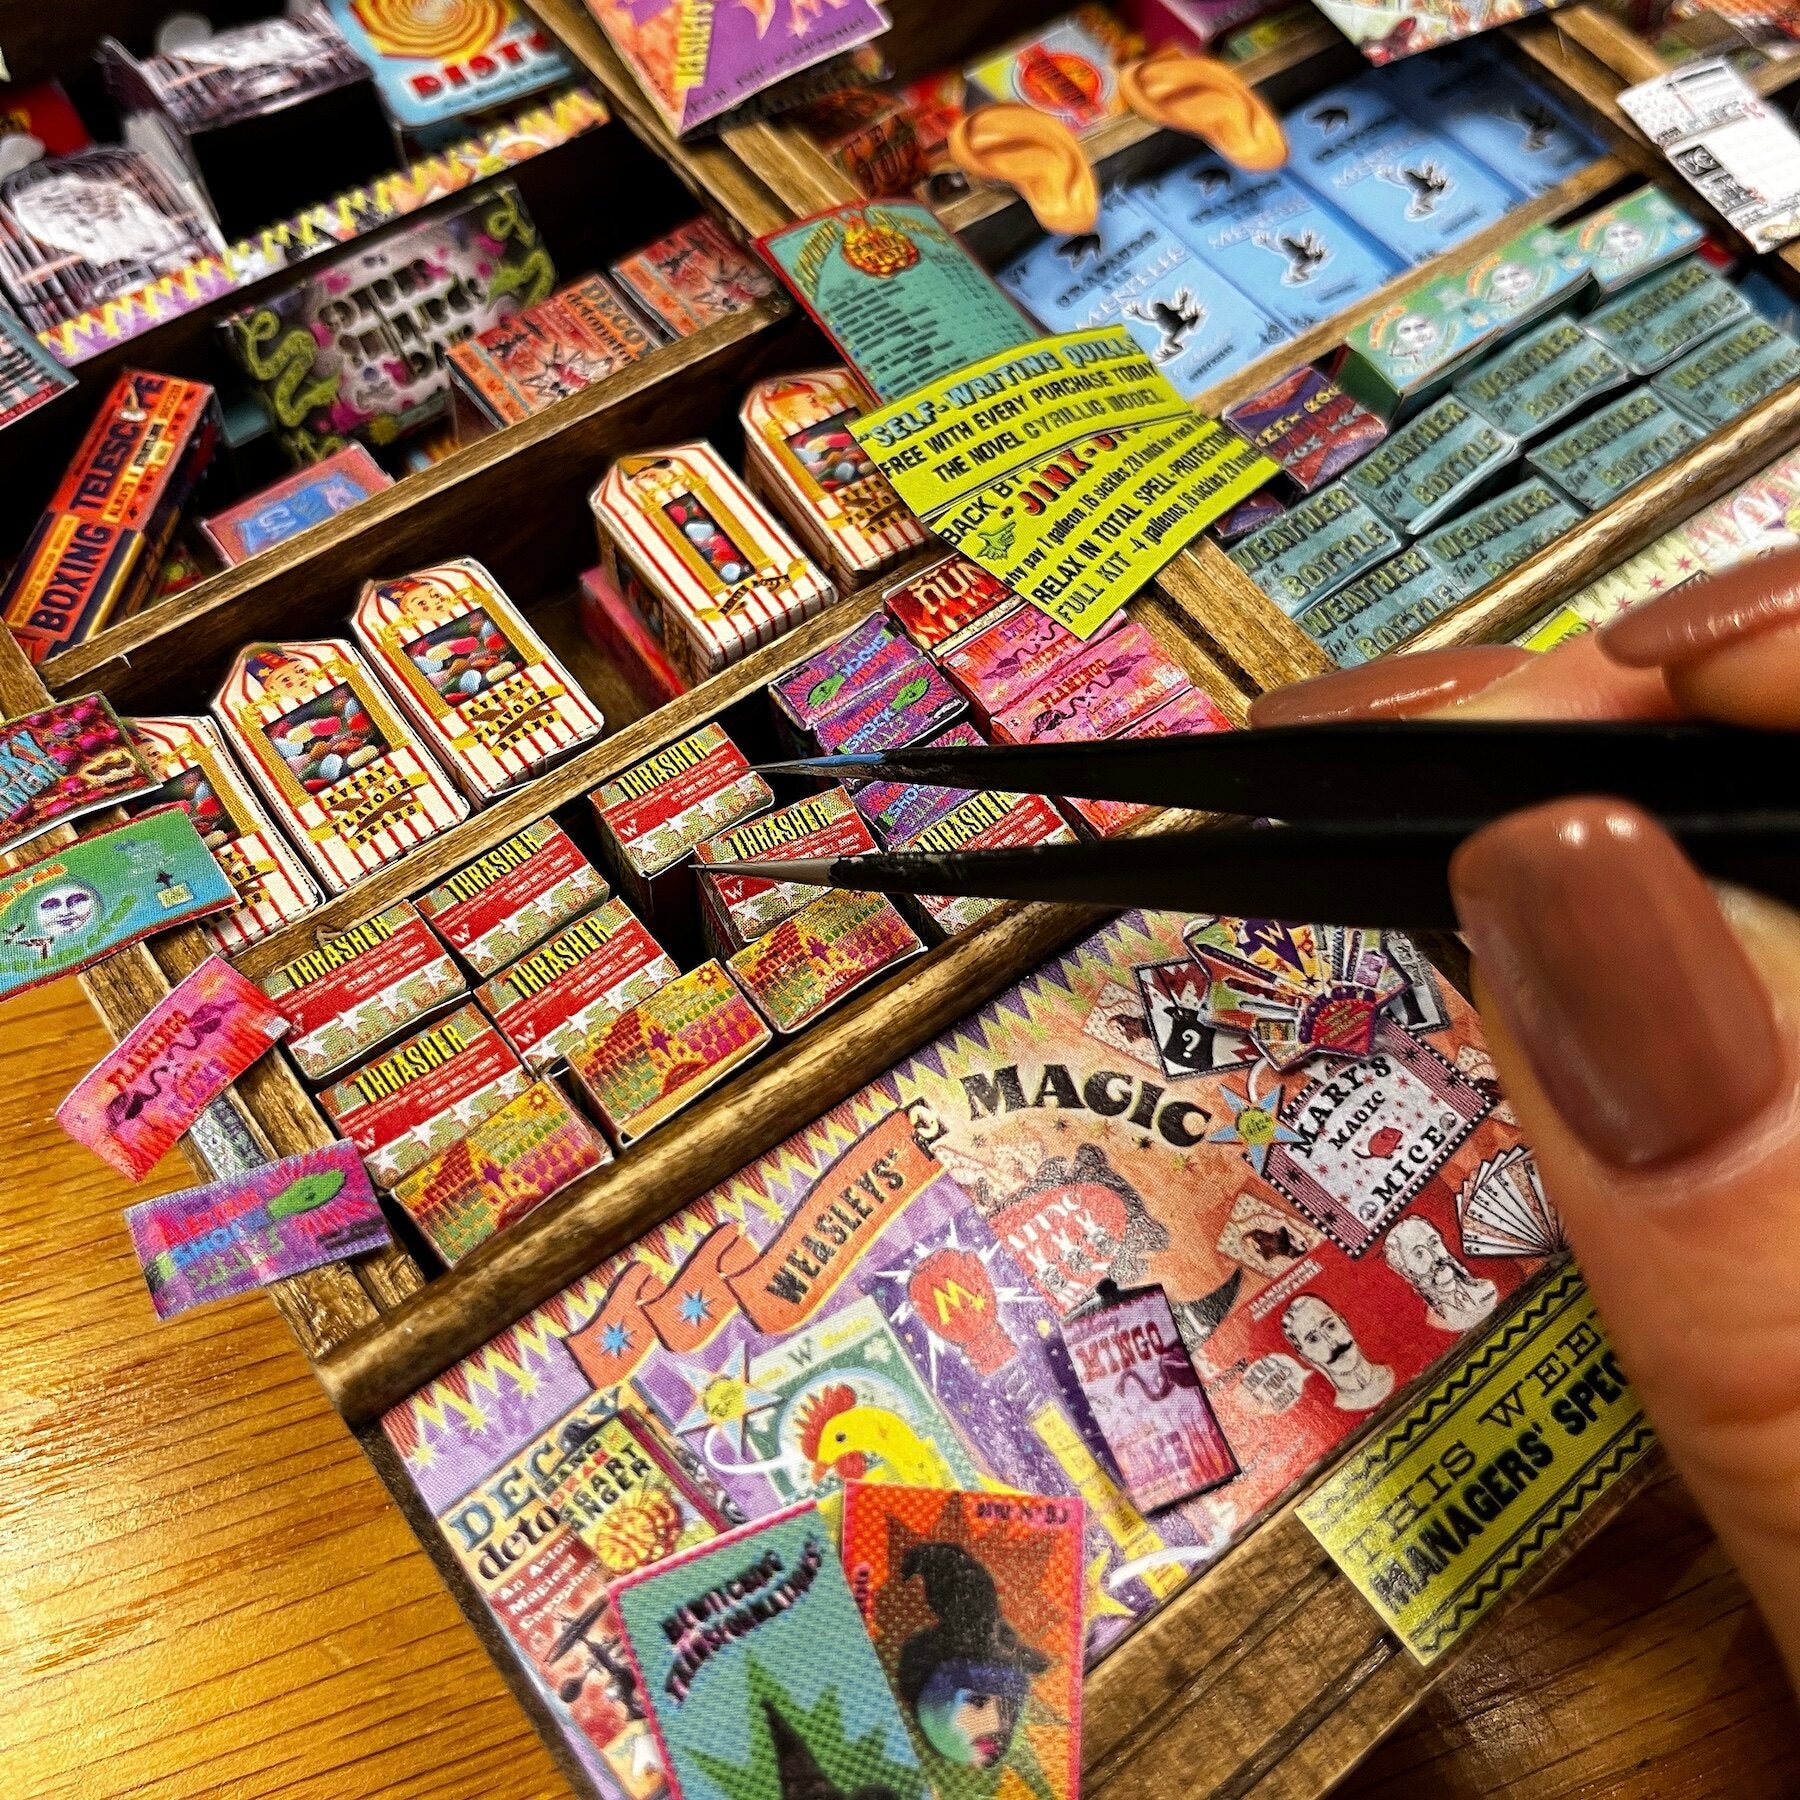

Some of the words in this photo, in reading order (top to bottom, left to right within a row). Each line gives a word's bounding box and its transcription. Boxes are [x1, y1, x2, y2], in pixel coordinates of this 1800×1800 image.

[876, 440, 927, 480] FREE
[924, 422, 976, 454] WITH
[972, 394, 1028, 431] EVERY
[1031, 369, 1112, 405] PURCHASE
[1113, 359, 1158, 387] TODAY
[932, 453, 968, 485] THE
[968, 431, 1027, 466] NOVEL
[1023, 397, 1107, 440] CYRILLIC
[1104, 388, 1165, 412] MODEL
[1355, 402, 1470, 489] WEATHER
[1544, 397, 1663, 471] WEATHER
[1411, 426, 1502, 508] BOTTLE
[942, 497, 998, 547] BACK
[1026, 545, 1049, 573] pay
[1032, 558, 1086, 606] RELAX
[1077, 540, 1100, 562] IN
[1095, 502, 1142, 546] TOTAL
[1228, 488, 1358, 576] WEATHER
[1280, 520, 1390, 600] BOTTLE
[1431, 486, 1561, 563] WEATHER
[27, 522, 112, 633] BOXING
[1055, 583, 1105, 624] FULL
[1095, 550, 1132, 584] KIT
[1300, 550, 1432, 640] WEATHER
[1355, 582, 1456, 660] BOTTLE
[469, 679, 528, 717] EVERY
[474, 689, 548, 743] FLAVOUR
[1040, 658, 1108, 709] FLAMINGO
[499, 713, 556, 752] BEANS
[616, 736, 712, 800] THRASHER
[326, 765, 390, 805] EVERY
[332, 777, 412, 836] FLAVOUR
[356, 804, 417, 846] BEANS
[728, 801, 833, 859] THRASHER
[446, 830, 543, 902] THRASHER
[285, 915, 396, 988] THRASHER
[507, 916, 614, 999] THRASHER
[353, 1022, 468, 1103] THRASHER
[960, 1062, 1213, 1147] MAGIC
[1291, 1055, 1392, 1159] MARY'S
[1330, 1089, 1387, 1151] MAGIC
[1372, 1122, 1448, 1209] MICE
[1077, 1321, 1168, 1384] MINGO
[1343, 1438, 1477, 1567] THIS
[1477, 1306, 1599, 1431] WEE
[478, 1504, 562, 1581] deto
[1370, 1424, 1553, 1605] MANAGERS'
[501, 1581, 526, 1601] An
